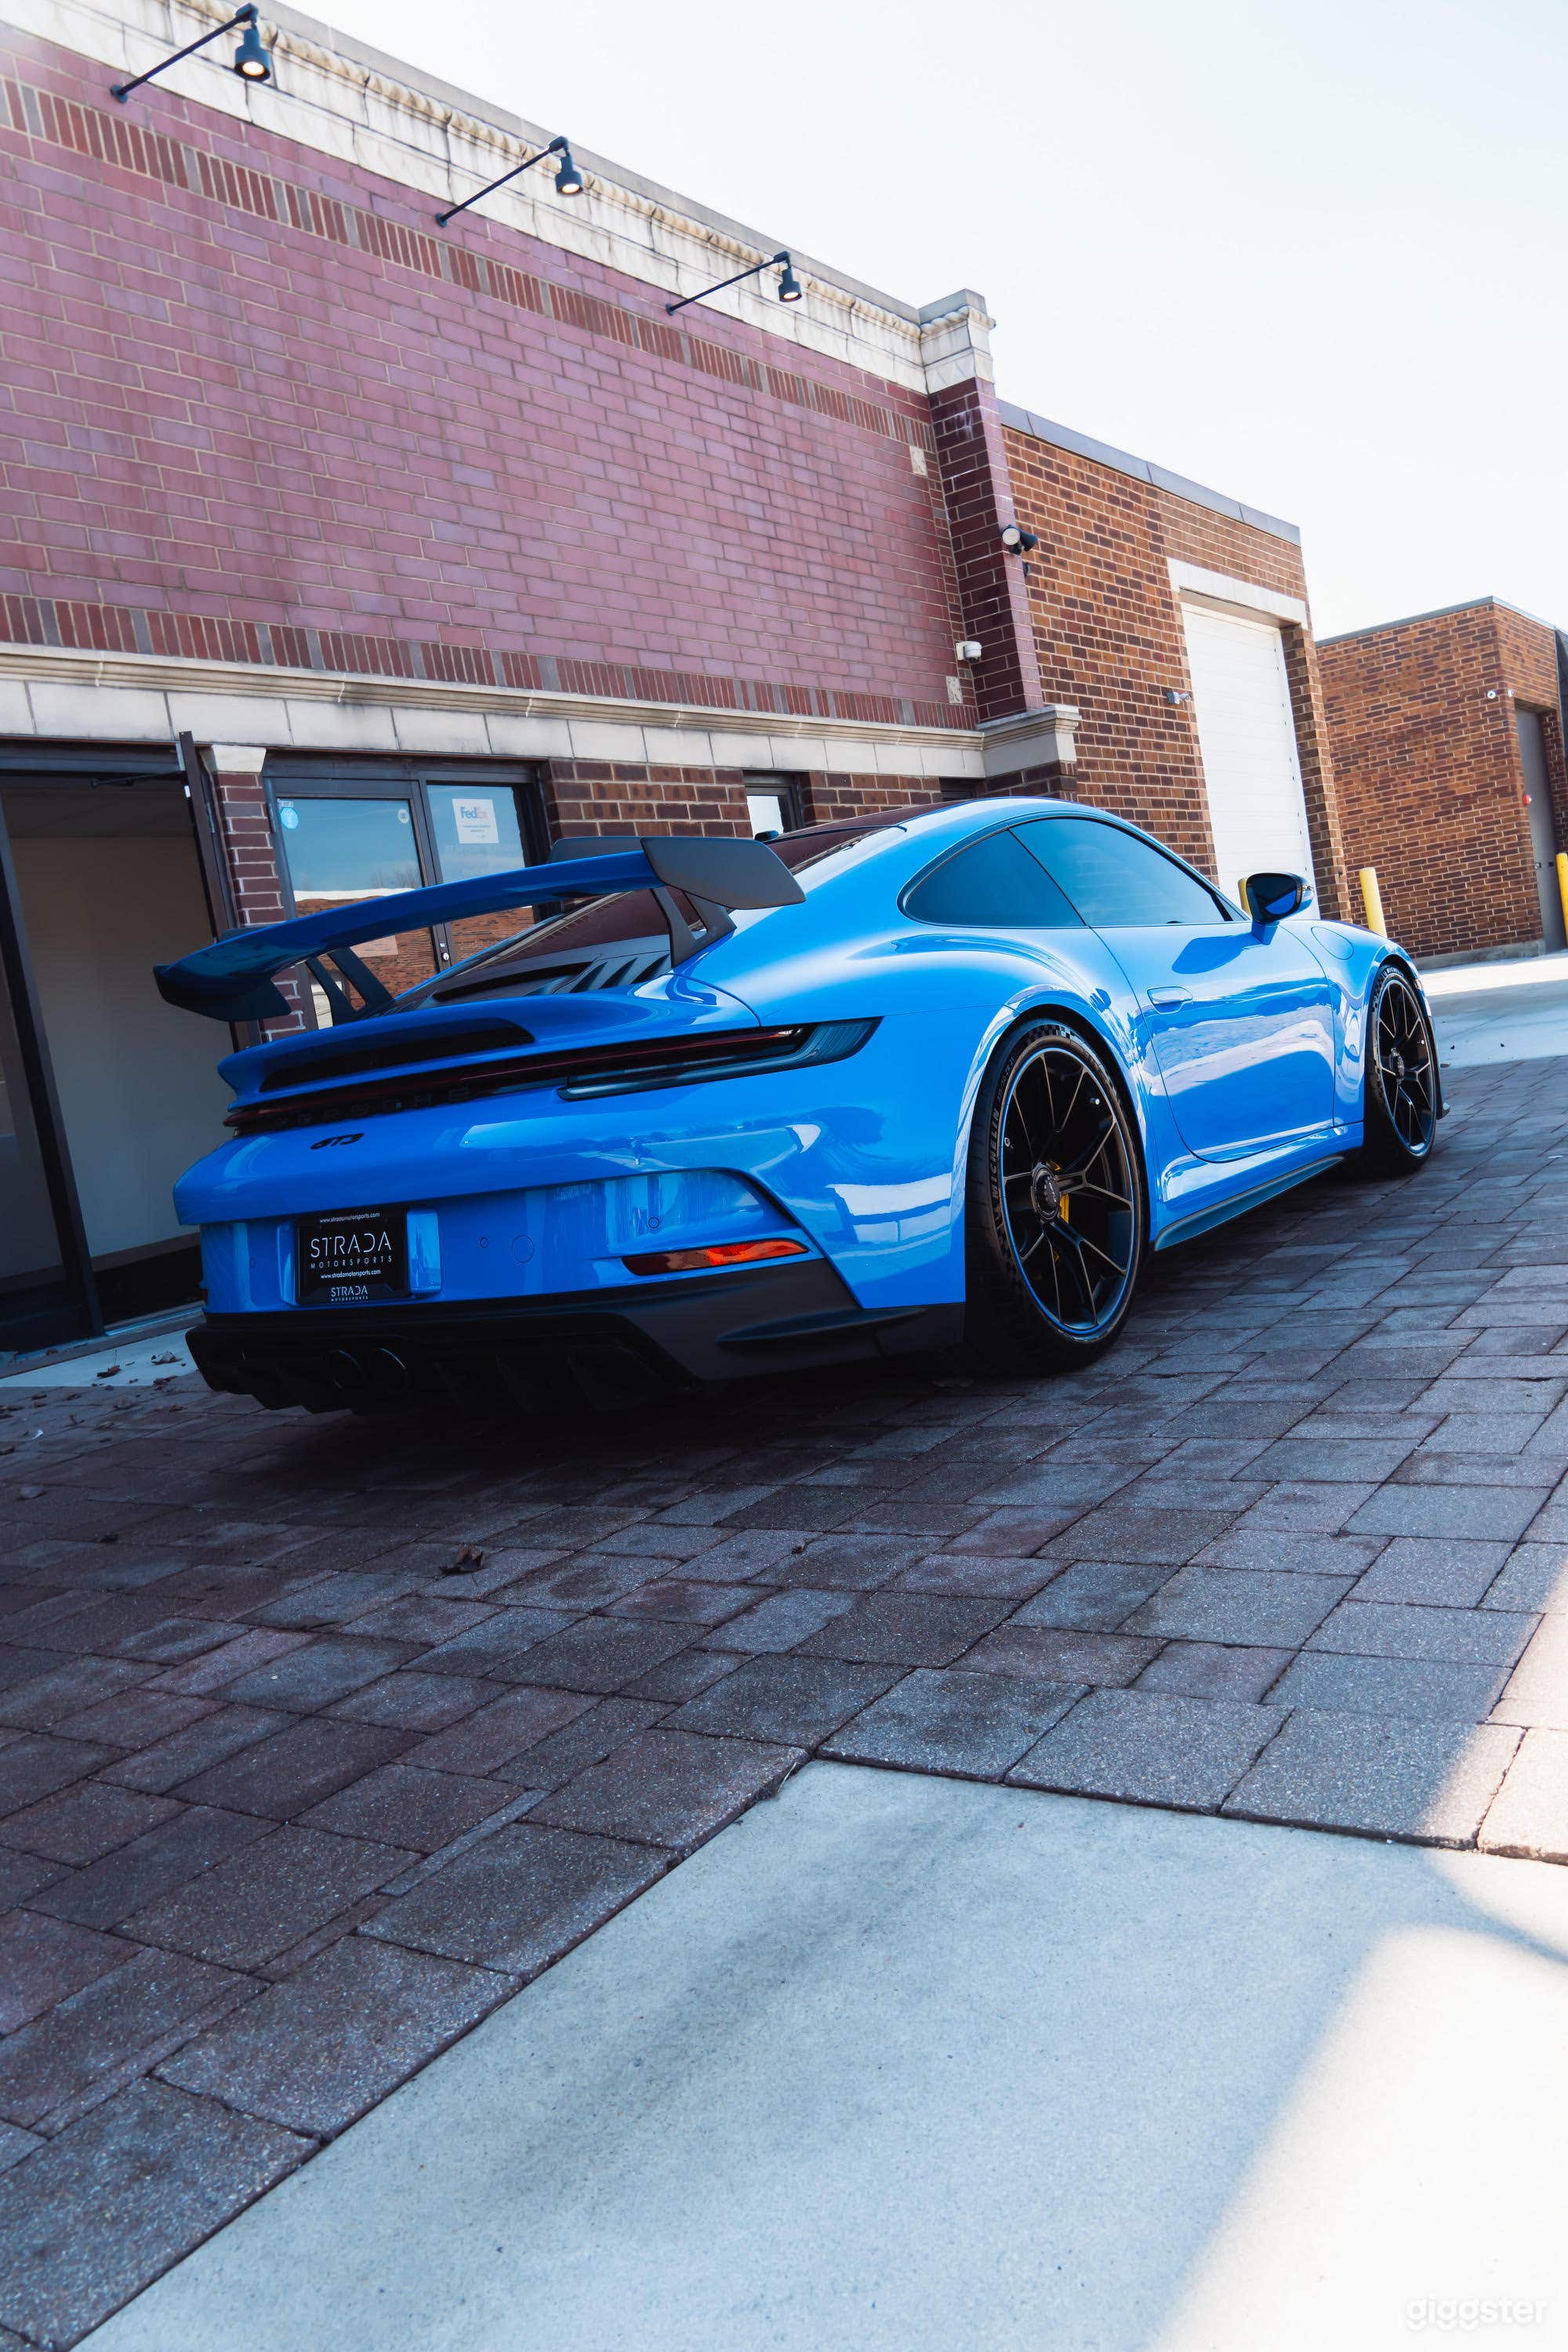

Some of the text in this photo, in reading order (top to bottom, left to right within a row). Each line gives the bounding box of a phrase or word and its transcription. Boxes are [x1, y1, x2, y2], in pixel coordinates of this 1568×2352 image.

[276, 1089, 471, 1125] RSCHE
[310, 1133, 365, 1150] GT3
[989, 1108, 1000, 1200] MICHELIN
[310, 1231, 392, 1258] STRADA
[310, 1255, 392, 1269] MOTORSPORTS
[320, 1269, 381, 1279] www.stradamotorsports.com
[330, 1285, 368, 1298] STRADA
